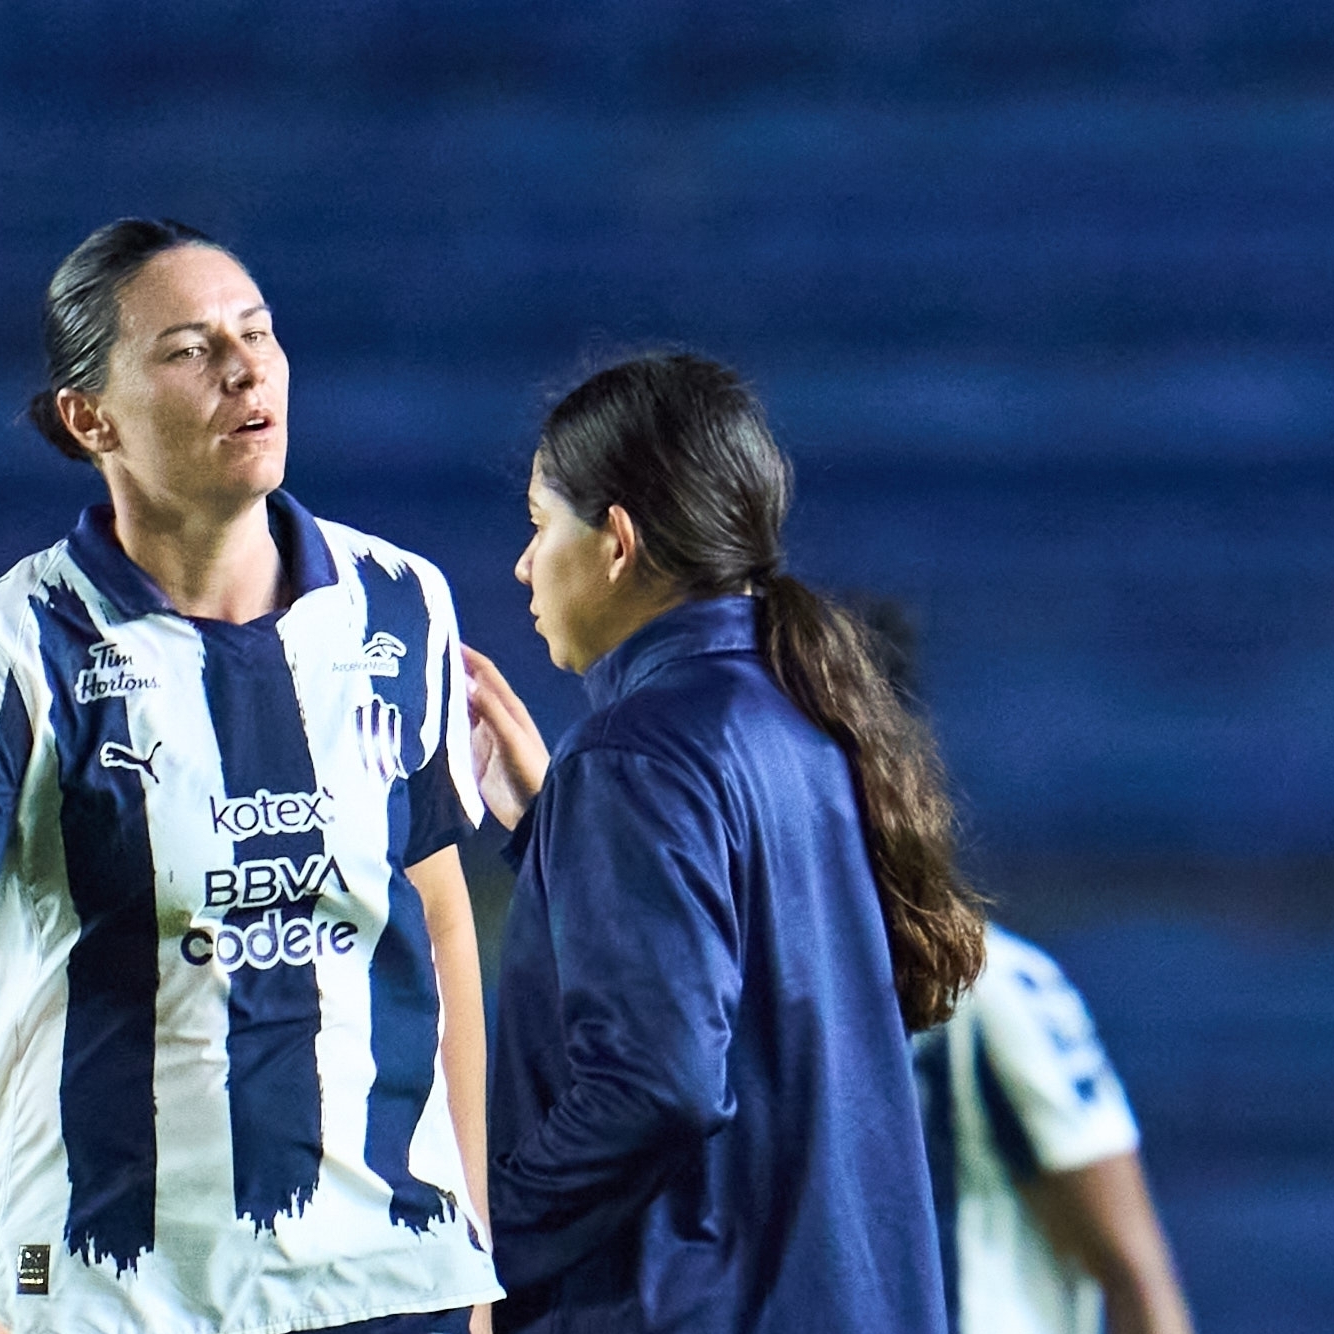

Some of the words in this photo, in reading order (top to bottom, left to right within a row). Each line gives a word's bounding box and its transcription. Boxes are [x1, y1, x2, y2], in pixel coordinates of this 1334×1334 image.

[93, 643, 133, 669] Tim
[81, 671, 157, 700] Hortons
[210, 795, 327, 835] kotex
[204, 855, 350, 908] BBVA
[180, 913, 359, 967] codere
